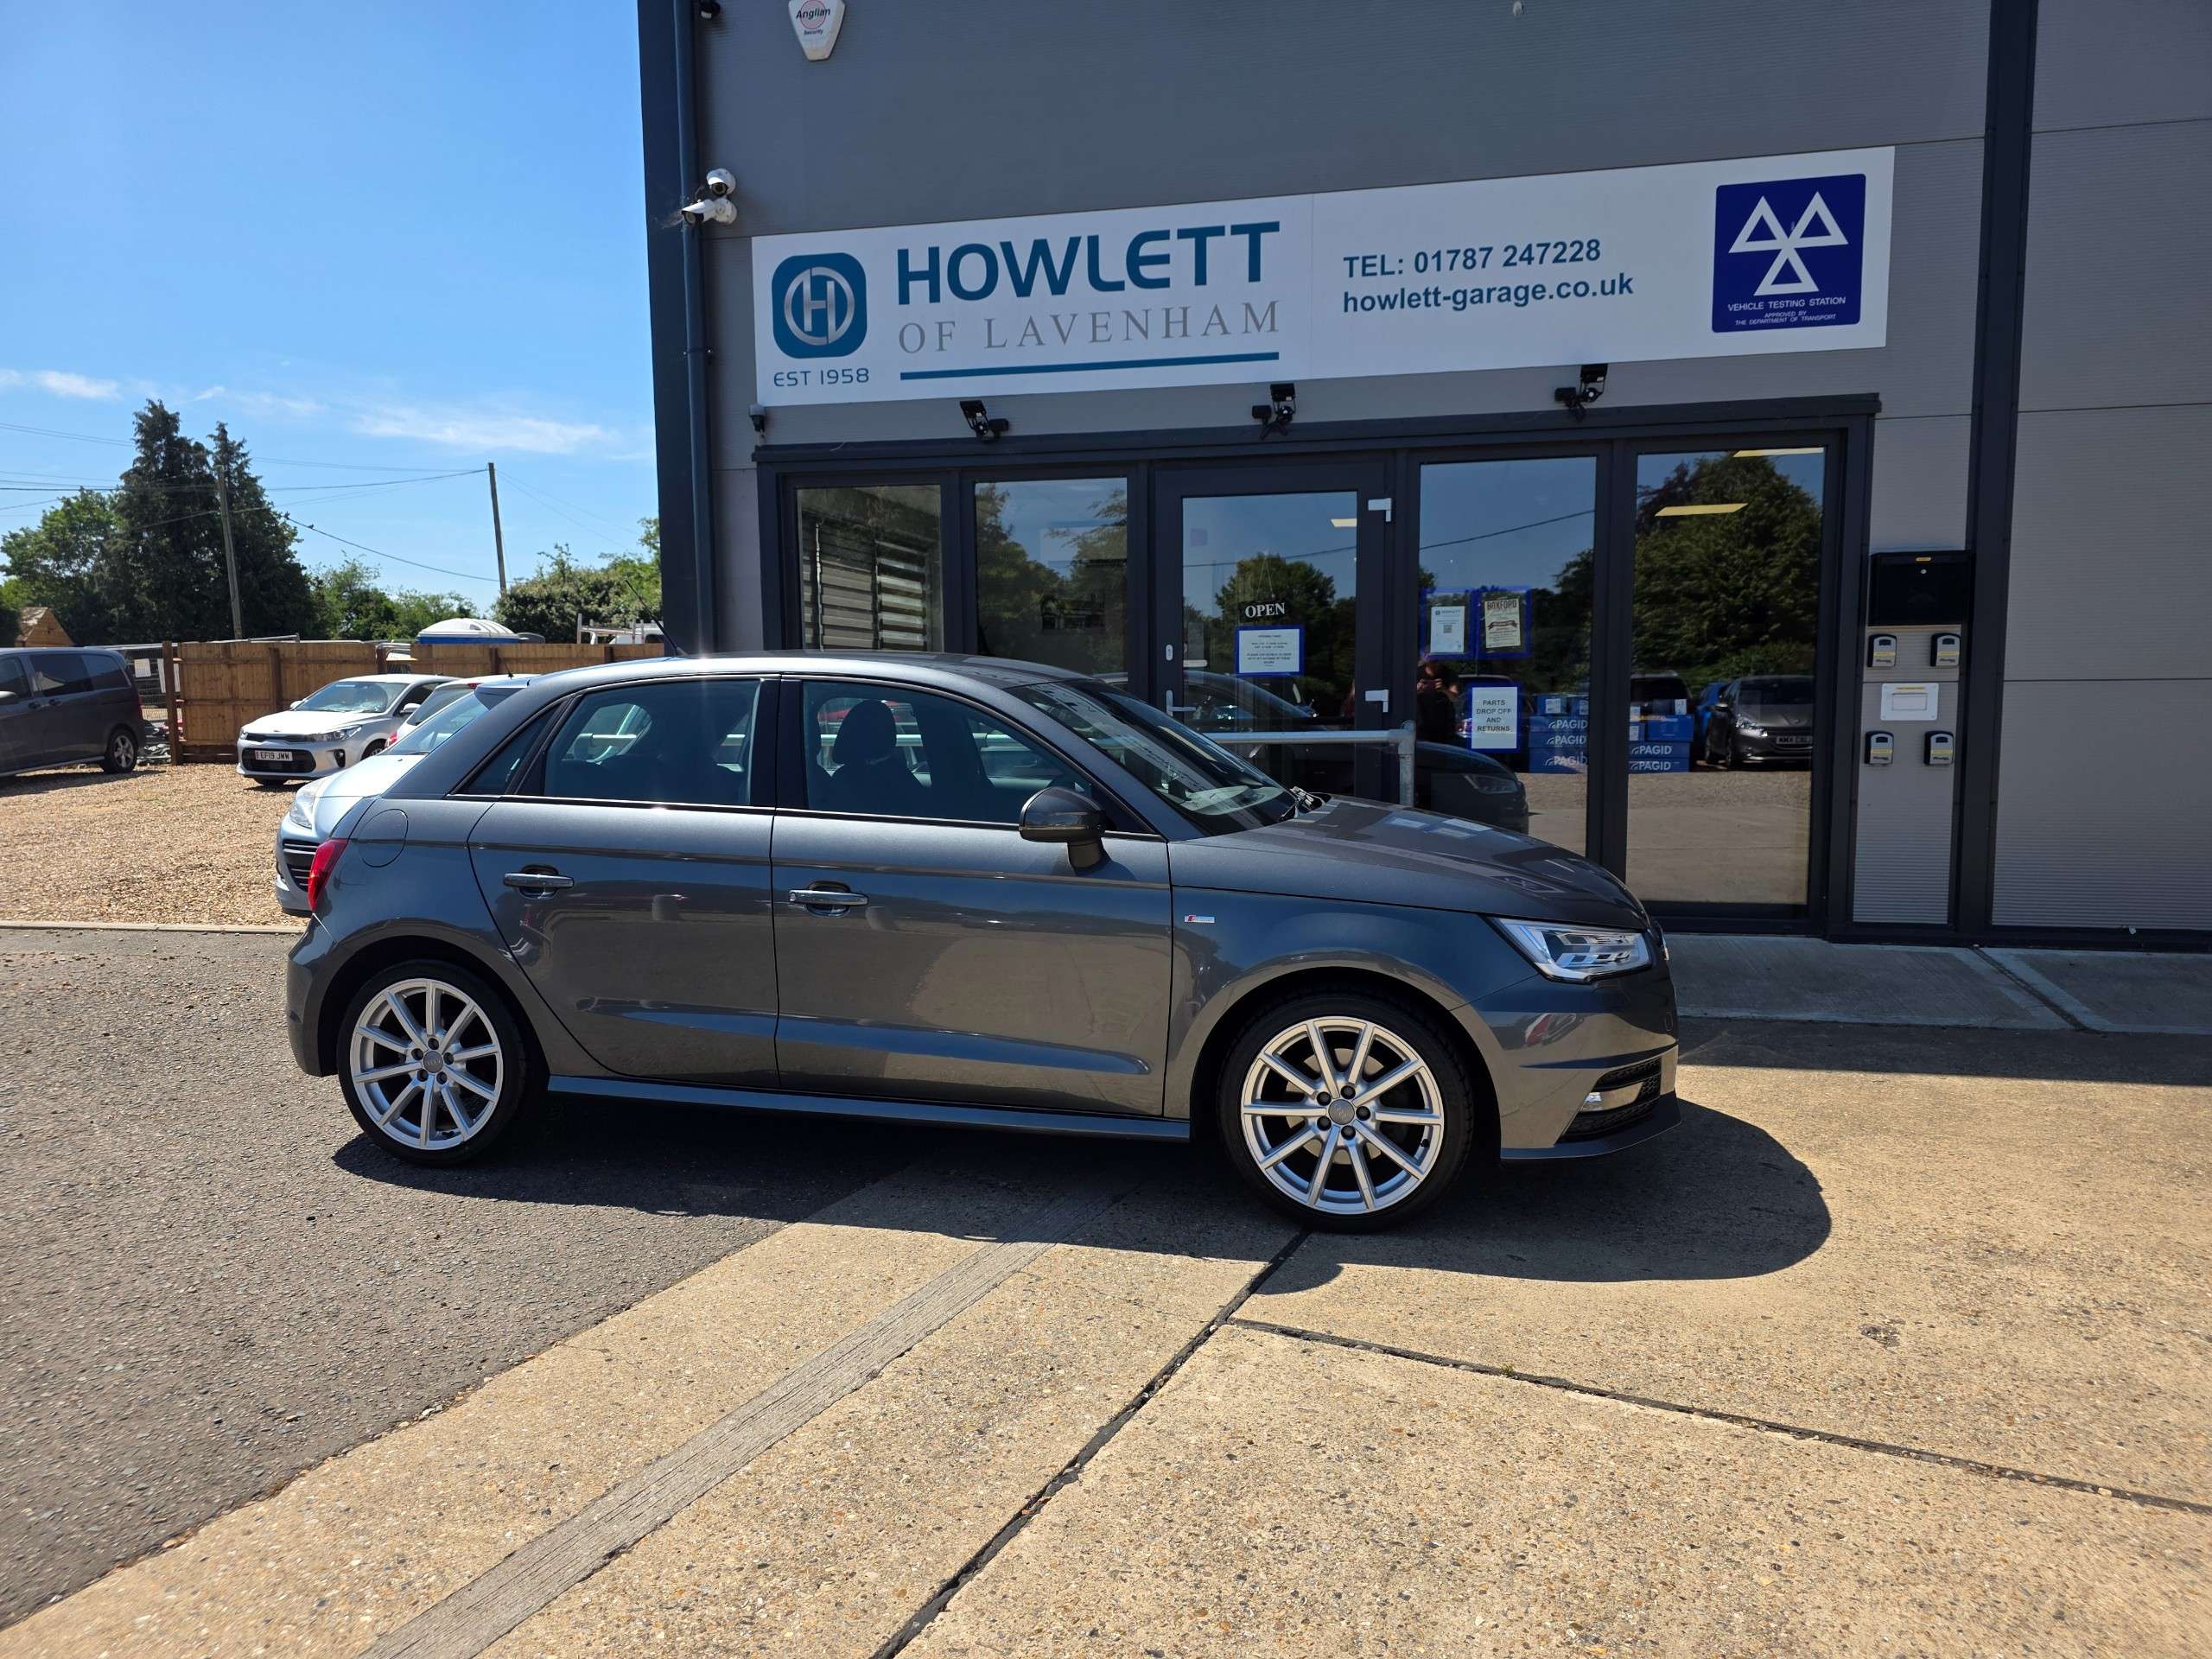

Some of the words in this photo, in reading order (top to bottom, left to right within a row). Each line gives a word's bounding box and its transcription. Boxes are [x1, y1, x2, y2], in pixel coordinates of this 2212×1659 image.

[796, 8, 830, 20] Anglian
[897, 221, 1281, 305] HOWLETT
[1344, 256, 1405, 279] TEL:
[1414, 247, 1493, 274] 01787
[1503, 238, 1601, 268] 247228
[1343, 272, 1634, 314] howlett-garage.co.uk
[1728, 302, 1764, 311] VEHICLE
[1768, 299, 1806, 309] TESTING
[1809, 296, 1846, 306] STATION
[899, 321, 957, 353] OF
[983, 300, 1280, 349] LAVENHAM
[1749, 317, 1788, 326] DEPARTMENT
[1802, 314, 1836, 322] TRANSPORT
[772, 370, 812, 388] EST
[819, 367, 870, 385] 1958
[1245, 602, 1286, 618] OPEN
[1555, 719, 1588, 729] PAGID
[1554, 734, 1587, 746] PAGID
[1639, 745, 1673, 755] PAGID
[1553, 755, 1588, 766] PAGID
[1638, 760, 1671, 771] PAGID
